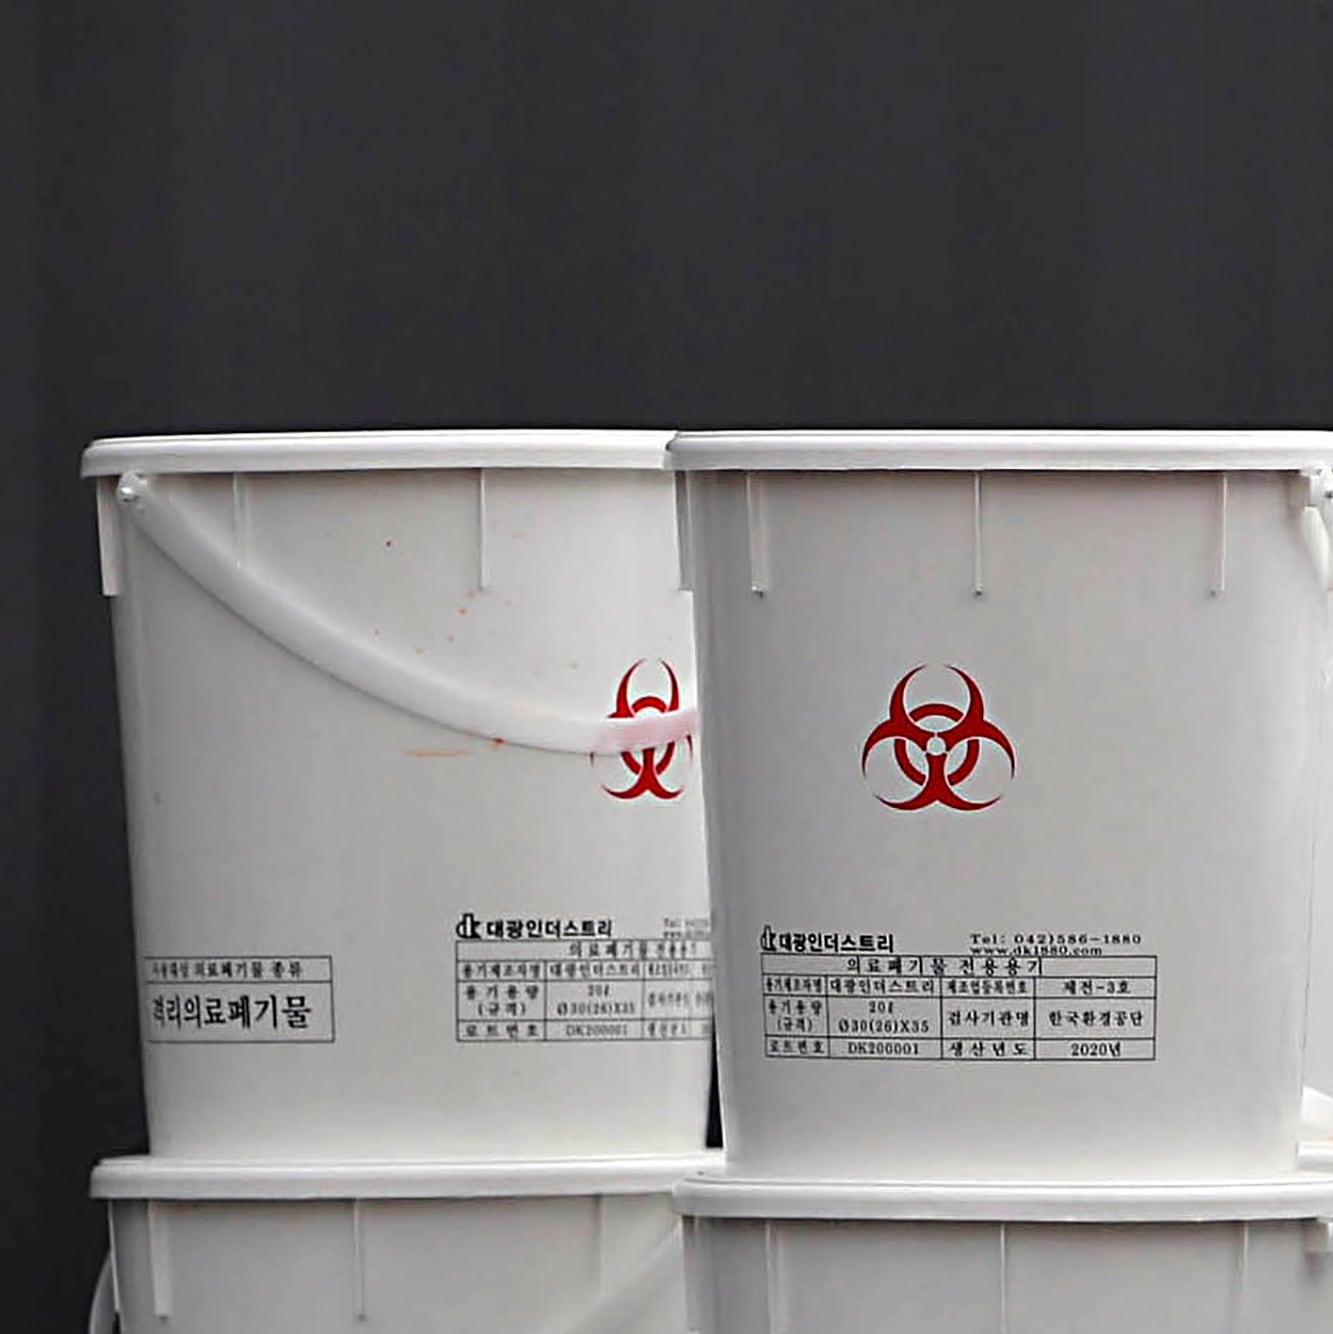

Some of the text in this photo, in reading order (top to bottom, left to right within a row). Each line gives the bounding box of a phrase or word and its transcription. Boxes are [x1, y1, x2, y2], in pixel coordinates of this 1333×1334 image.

[487, 919, 612, 938] 대광인더스트리
[779, 933, 893, 952] 대광인더스트리
[970, 934, 1141, 945] Tel: 042)586-1880
[970, 946, 1102, 956] www.dk1880.com
[847, 957, 1041, 975] 의료폐기물 전용용기
[830, 979, 934, 993] 대광인더스트리
[153, 994, 311, 1029] 격리의료폐기물
[949, 1011, 1029, 1026] 검사기관명
[1049, 1011, 1142, 1026] 한국환경공단
[848, 1042, 919, 1055] DK200001
[950, 1041, 1028, 1057] 생산년도
[1071, 1042, 1121, 1057] 2020년
